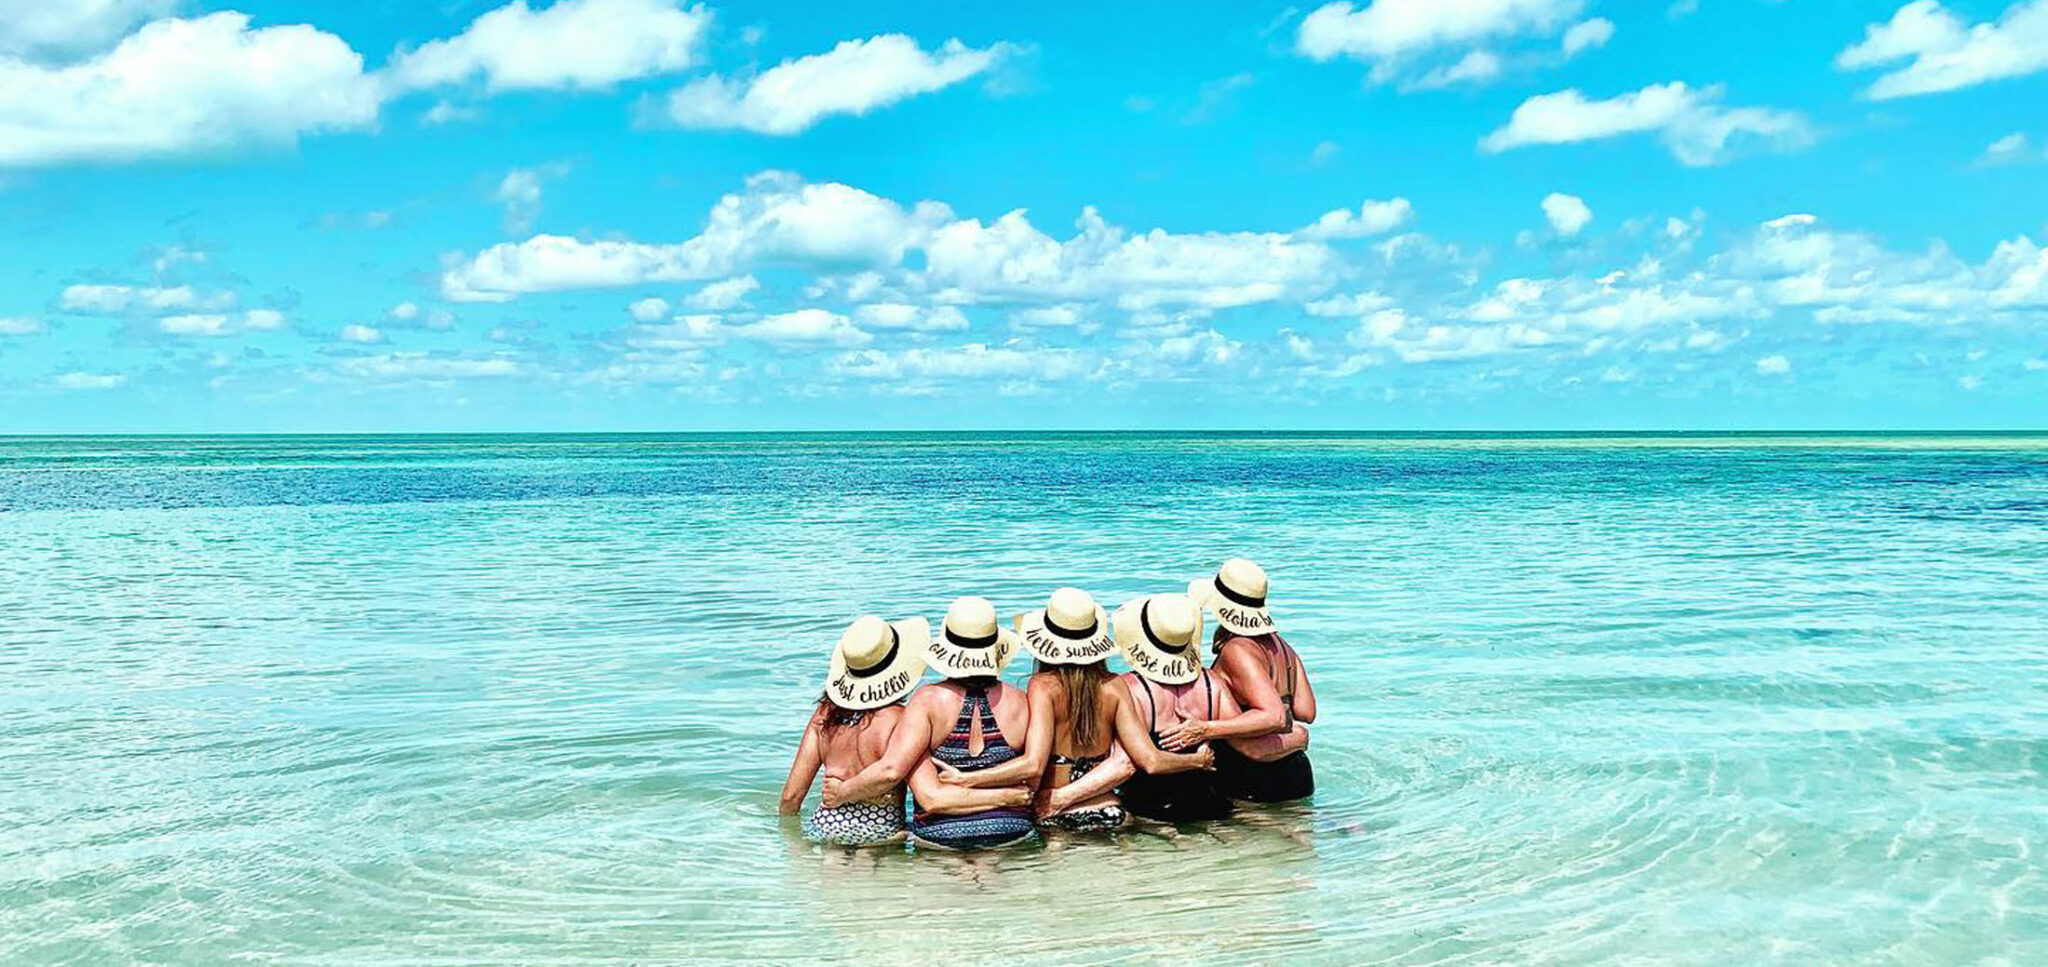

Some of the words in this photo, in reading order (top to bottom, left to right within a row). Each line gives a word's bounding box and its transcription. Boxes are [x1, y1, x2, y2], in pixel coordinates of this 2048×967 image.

[1219, 607, 1261, 628] aloha
[929, 643, 948, 660] on
[948, 650, 994, 669] cloud
[1026, 628, 1060, 658] hello
[1066, 634, 1115, 658] sunshin
[1128, 643, 1159, 672] rosé
[1162, 659, 1186, 678] all
[860, 671, 910, 703] chillin
